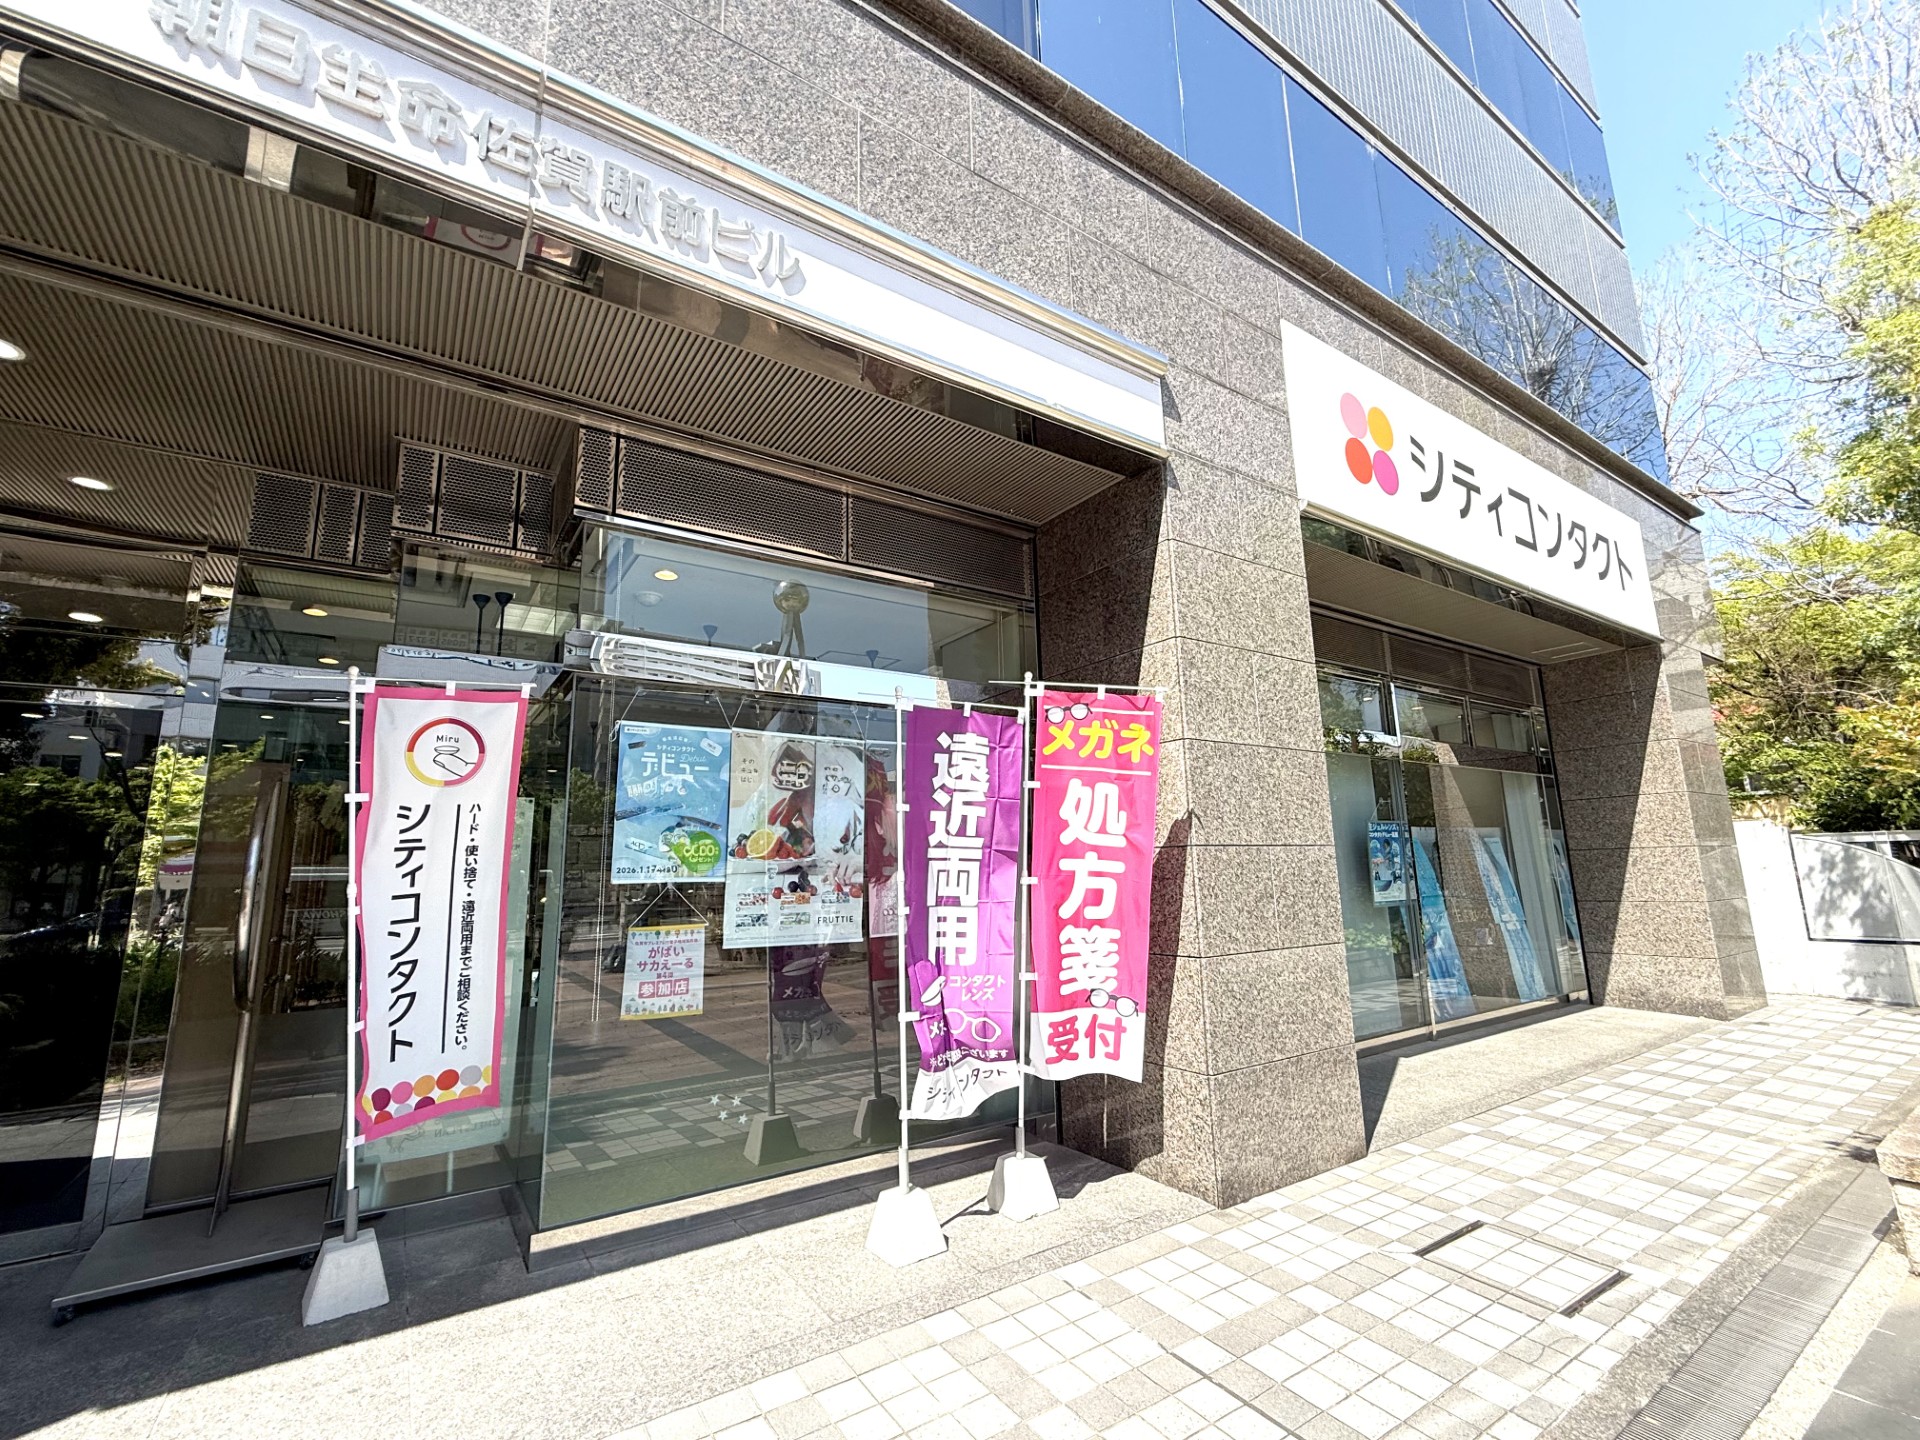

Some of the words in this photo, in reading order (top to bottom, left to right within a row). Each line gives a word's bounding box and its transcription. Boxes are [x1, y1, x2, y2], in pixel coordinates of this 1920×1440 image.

[1409, 434, 1633, 592] シティコンタクト
[436, 734, 460, 743] Miru
[1042, 719, 1155, 763] メガネ
[641, 751, 710, 783] デビュー
[926, 731, 991, 967] 遠近両用
[1058, 777, 1127, 996] 処方箋
[817, 915, 854, 925] FRUTTIE
[387, 804, 431, 1063] シティコンタクト
[648, 946, 685, 959] がばい
[637, 958, 694, 972] サカえーる
[640, 980, 688, 996] 参加店
[949, 974, 1007, 988] コンタクト
[962, 988, 996, 1001] レンズ
[1045, 1013, 1127, 1066] 受付
